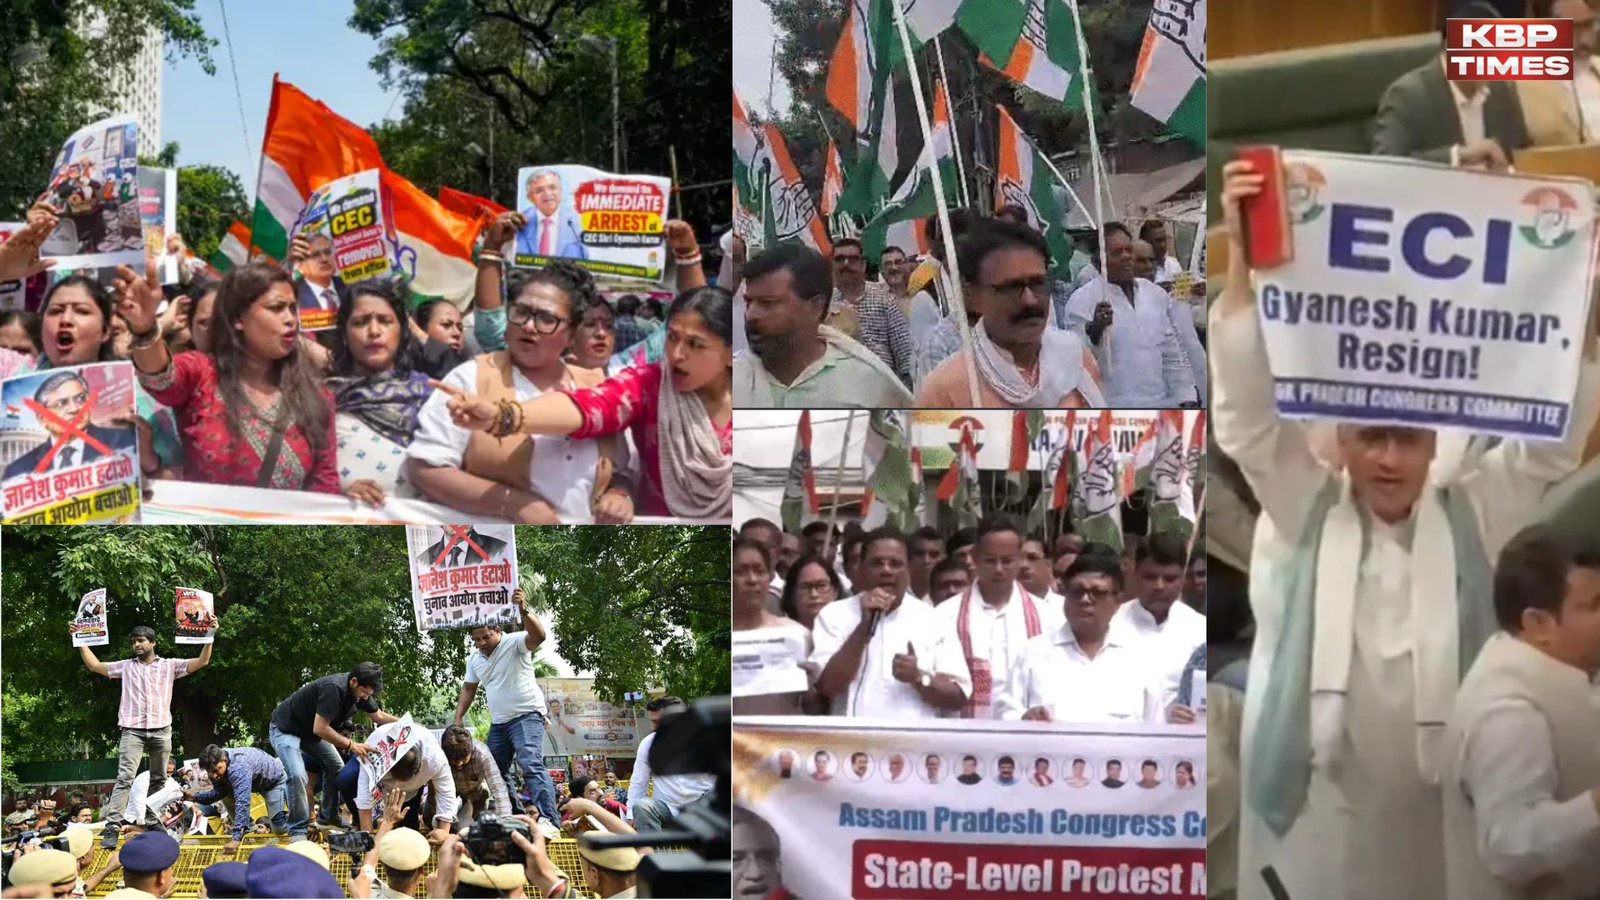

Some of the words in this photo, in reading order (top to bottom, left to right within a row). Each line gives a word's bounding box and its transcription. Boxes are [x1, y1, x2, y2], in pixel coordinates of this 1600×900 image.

[329, 202, 342, 215] We
[342, 191, 375, 209] demand
[581, 194, 661, 211] IMMEDIATE
[594, 183, 606, 193] We
[609, 183, 640, 194] demand
[641, 185, 652, 195] the
[331, 205, 372, 236] CEC
[588, 213, 649, 231] ARREST
[649, 222, 657, 231] of
[338, 241, 384, 266] removal
[583, 233, 598, 243] CEC
[598, 233, 612, 243] Shri
[1328, 203, 1512, 285] ECI
[343, 267, 363, 279] from
[364, 261, 388, 276] office
[1262, 284, 1417, 333] Gyanesh
[1429, 298, 1570, 350] Kumar,
[1338, 333, 1481, 380] Resign!
[1300, 383, 1368, 407] PRADESH
[1369, 387, 1458, 415] CONGRESS
[1463, 395, 1562, 426] COMMITTEE
[4, 473, 51, 512] ज्ञानेश
[53, 465, 93, 501] कुमार
[95, 453, 134, 484] हटाओ
[50, 496, 91, 524] आयोग
[95, 482, 133, 512] बचाओ
[418, 567, 448, 593] ज्ञानेश
[449, 566, 479, 592] कुमार
[480, 558, 512, 585] हटाओ
[423, 595, 448, 615] चुनाव
[449, 589, 477, 608] आयोग
[478, 586, 509, 605] बचाओ
[838, 802, 928, 832] Assam
[934, 806, 1044, 835] Pradesh
[1049, 808, 1177, 839] Congress
[863, 853, 1054, 892] State-Level
[1060, 859, 1184, 895] Protest
